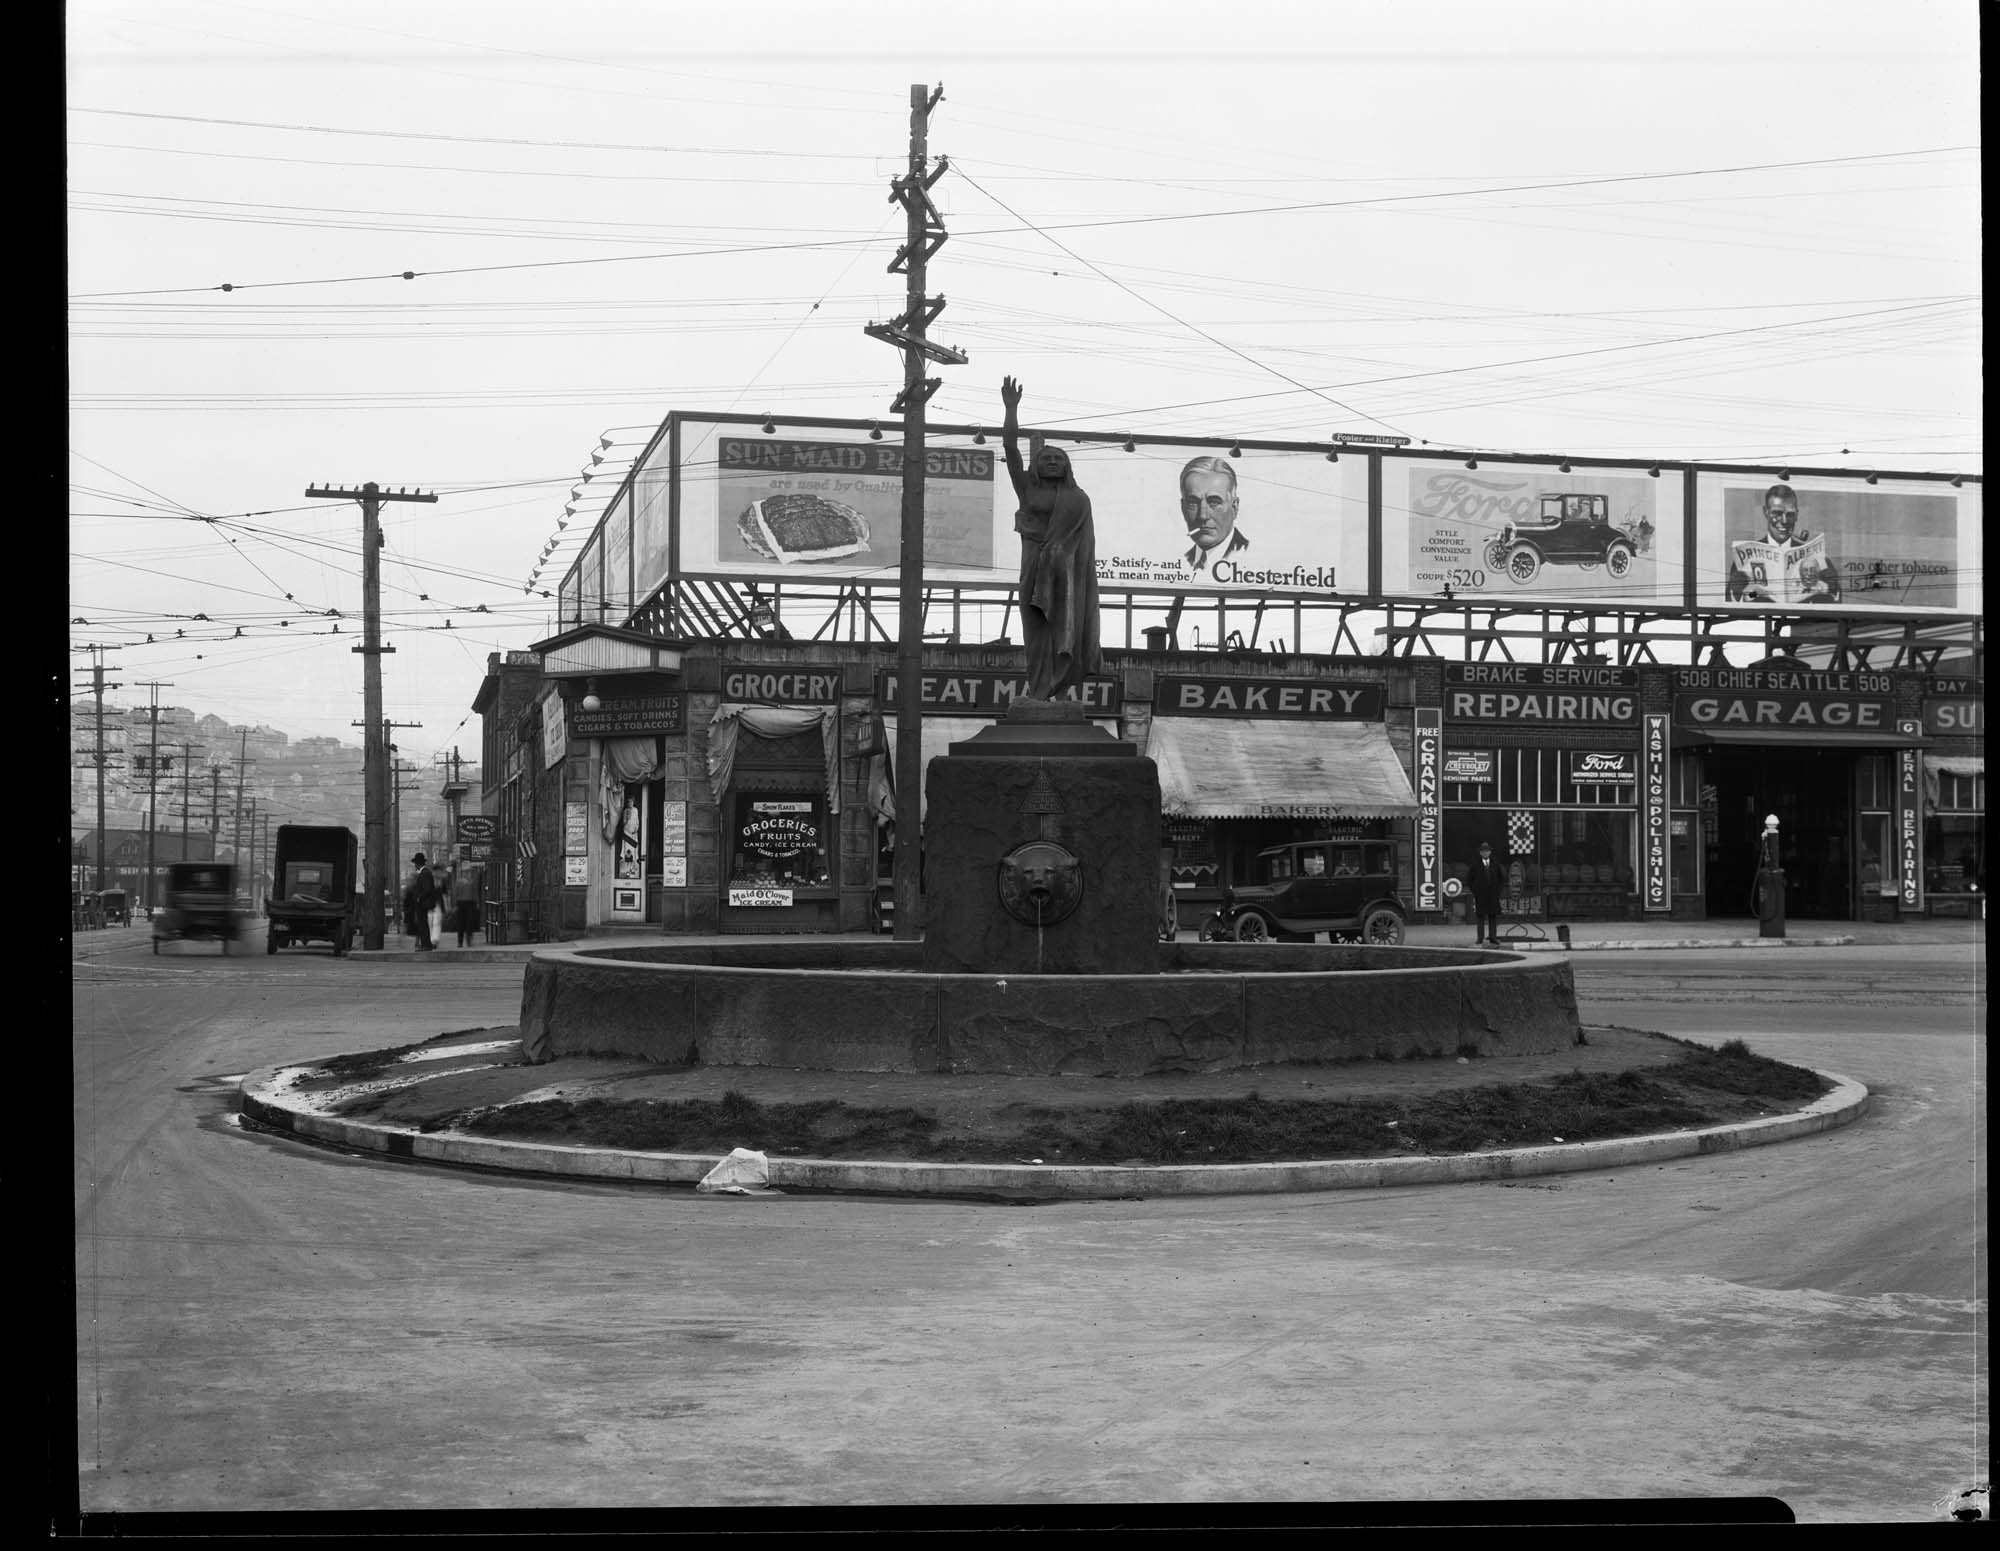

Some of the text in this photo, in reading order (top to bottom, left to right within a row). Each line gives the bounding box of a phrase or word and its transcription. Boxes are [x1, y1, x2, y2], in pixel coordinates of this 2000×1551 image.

[726, 441, 988, 476] SUN MAID RSINS
[769, 478, 792, 489] are
[797, 477, 829, 491] used
[832, 478, 853, 494] by
[1415, 473, 1541, 520] Ford
[1420, 546, 1472, 554] CONVENIENCE
[1428, 538, 1465, 546] COMFORT
[1095, 559, 1108, 570] ey
[1736, 547, 1780, 565] PRINCE
[1096, 569, 1115, 580] on't
[1119, 572, 1150, 580] mean
[1212, 560, 1336, 588] Chesterfield
[1844, 562, 1865, 572] no
[1902, 560, 1948, 575] tobacco
[1446, 569, 1486, 587] $520
[1463, 666, 1622, 686] BRAKE SERVICE
[1679, 670, 1890, 692] 508 CHIEF SEATTLE 508
[726, 673, 839, 700] GROCERY
[994, 680, 1114, 706] MET
[1936, 680, 1967, 692] DAY
[640, 696, 679, 710] FRUITS
[1178, 683, 1364, 714] BAKERY
[1454, 692, 1633, 720] REPAIRING
[618, 712, 640, 721] SOFT
[642, 710, 678, 720] DRINKS
[1690, 698, 1882, 726] GARAGE
[578, 722, 612, 732] CIGARS
[624, 720, 674, 730] TOBACCOS
[1416, 727, 1439, 737] FREE
[1581, 753, 1624, 771] Ford
[1650, 718, 1662, 794] WASHING
[1420, 740, 1436, 804] CRANK
[1449, 762, 1486, 770] CHEVROLET
[1260, 804, 1340, 814] BAKERY
[742, 818, 817, 837] GROCERIES
[758, 848, 774, 857] CIGARS
[1650, 806, 1663, 900] POLISHING
[1904, 809, 1916, 899] REPAIRING
[1420, 818, 1436, 908] SERVICE
[732, 890, 755, 902] Maid
